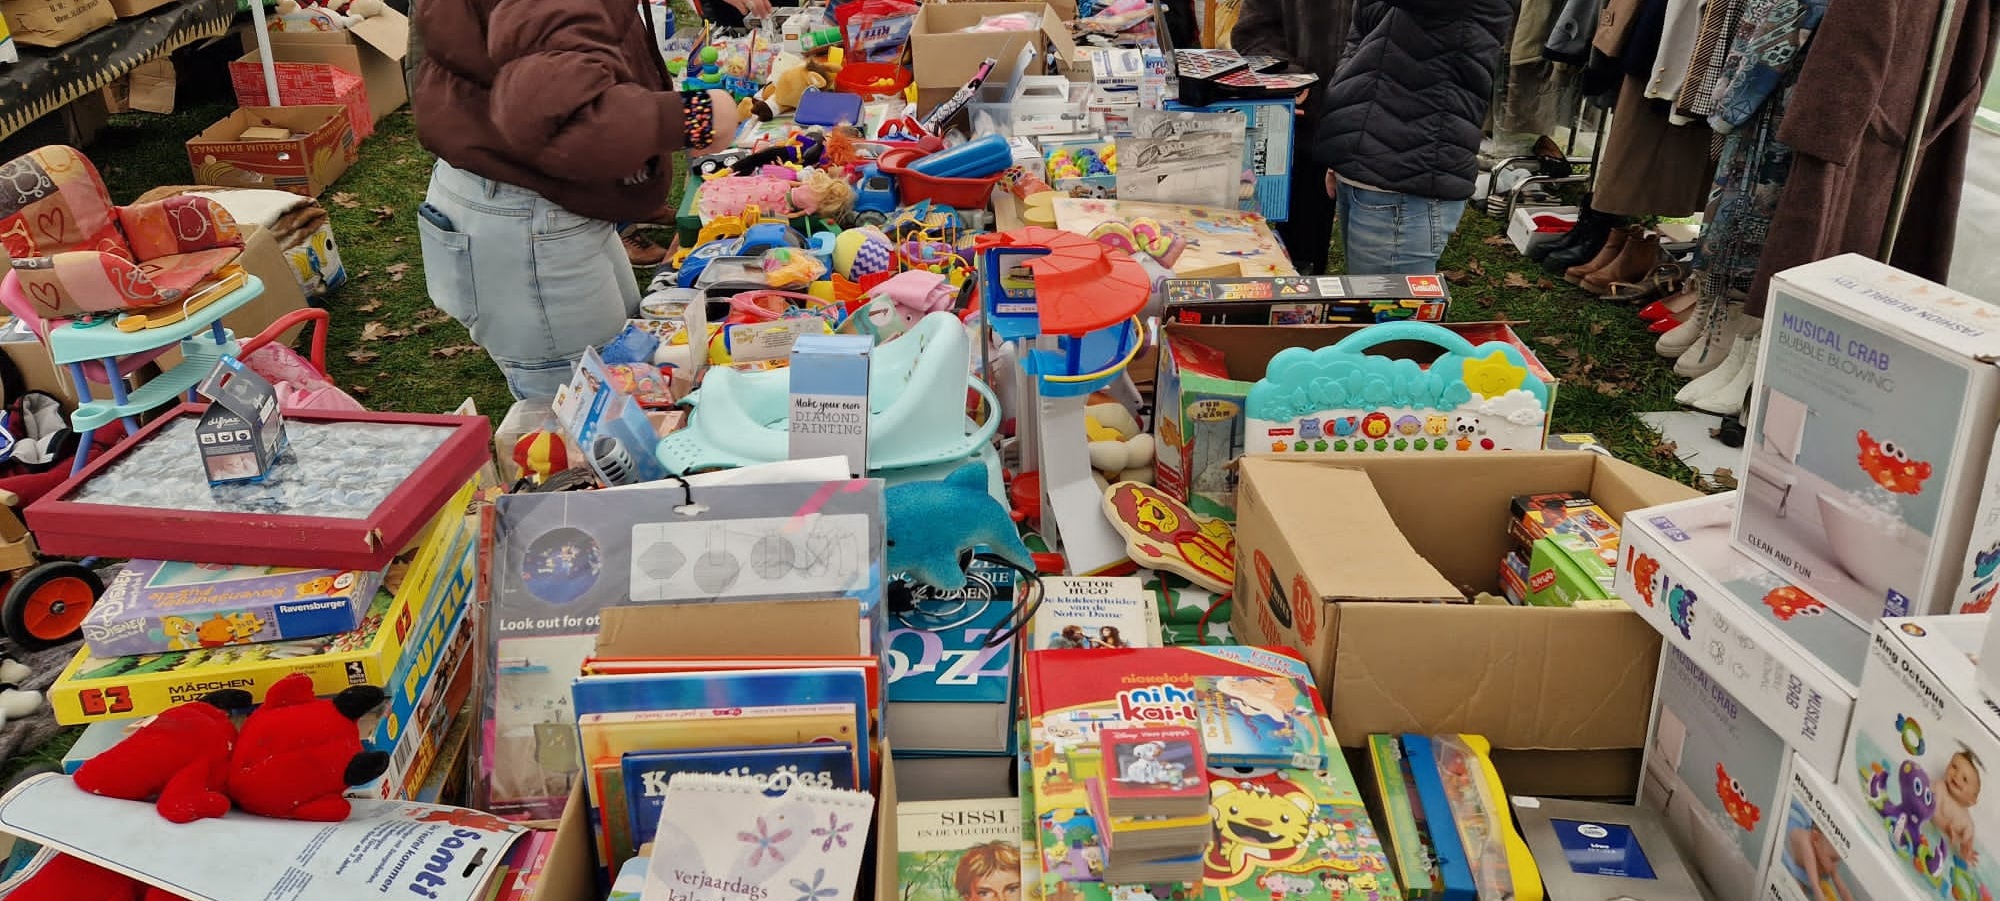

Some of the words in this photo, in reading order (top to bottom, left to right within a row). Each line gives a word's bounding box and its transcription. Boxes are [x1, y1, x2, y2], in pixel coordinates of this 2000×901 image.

[192, 144, 245, 154] BANANAS
[247, 143, 298, 152] PREMIUM
[1917, 310, 1985, 337] FASHION
[1782, 310, 1843, 352] MUSICAL
[1847, 339, 1889, 371] CRAB
[1778, 331, 1825, 362] BUBBLE
[1827, 352, 1896, 393] BLOWING
[795, 397, 818, 408] Make
[817, 400, 840, 414] your
[842, 402, 861, 410] own
[1197, 411, 1231, 419] LEARN
[795, 411, 860, 423] DIAMOND
[791, 422, 863, 435] PAINTING
[1748, 533, 1773, 556] CLEAN
[1774, 551, 1793, 567] AND
[1794, 561, 1812, 578] FUN
[1063, 580, 1114, 588] VICTOR
[279, 599, 347, 614] Ravensburger
[1053, 610, 1086, 618] Notre
[1091, 603, 1106, 611] de
[499, 618, 534, 632] Look
[536, 617, 560, 629] out
[562, 614, 583, 628] for
[1875, 633, 1899, 664] Ring
[1901, 659, 1945, 709] Octopus
[168, 678, 255, 694] MÄRCHEN
[1672, 645, 1710, 691] MUSICAL
[1711, 685, 1738, 720] CRAB
[1786, 673, 1803, 710] CRAB
[79, 685, 133, 716] 63
[171, 693, 207, 704] PUZ
[1120, 694, 1198, 721] kai-l
[1801, 688, 1823, 742] MUSICAL
[940, 808, 1009, 827] SISSI
[1795, 772, 1814, 802] Ring
[1815, 800, 1851, 850] Octopus
[917, 828, 934, 838] EN
[936, 828, 951, 837] DE
[379, 849, 417, 894] kommen
[409, 828, 482, 900] Samti
[674, 868, 769, 901] verjaardags
